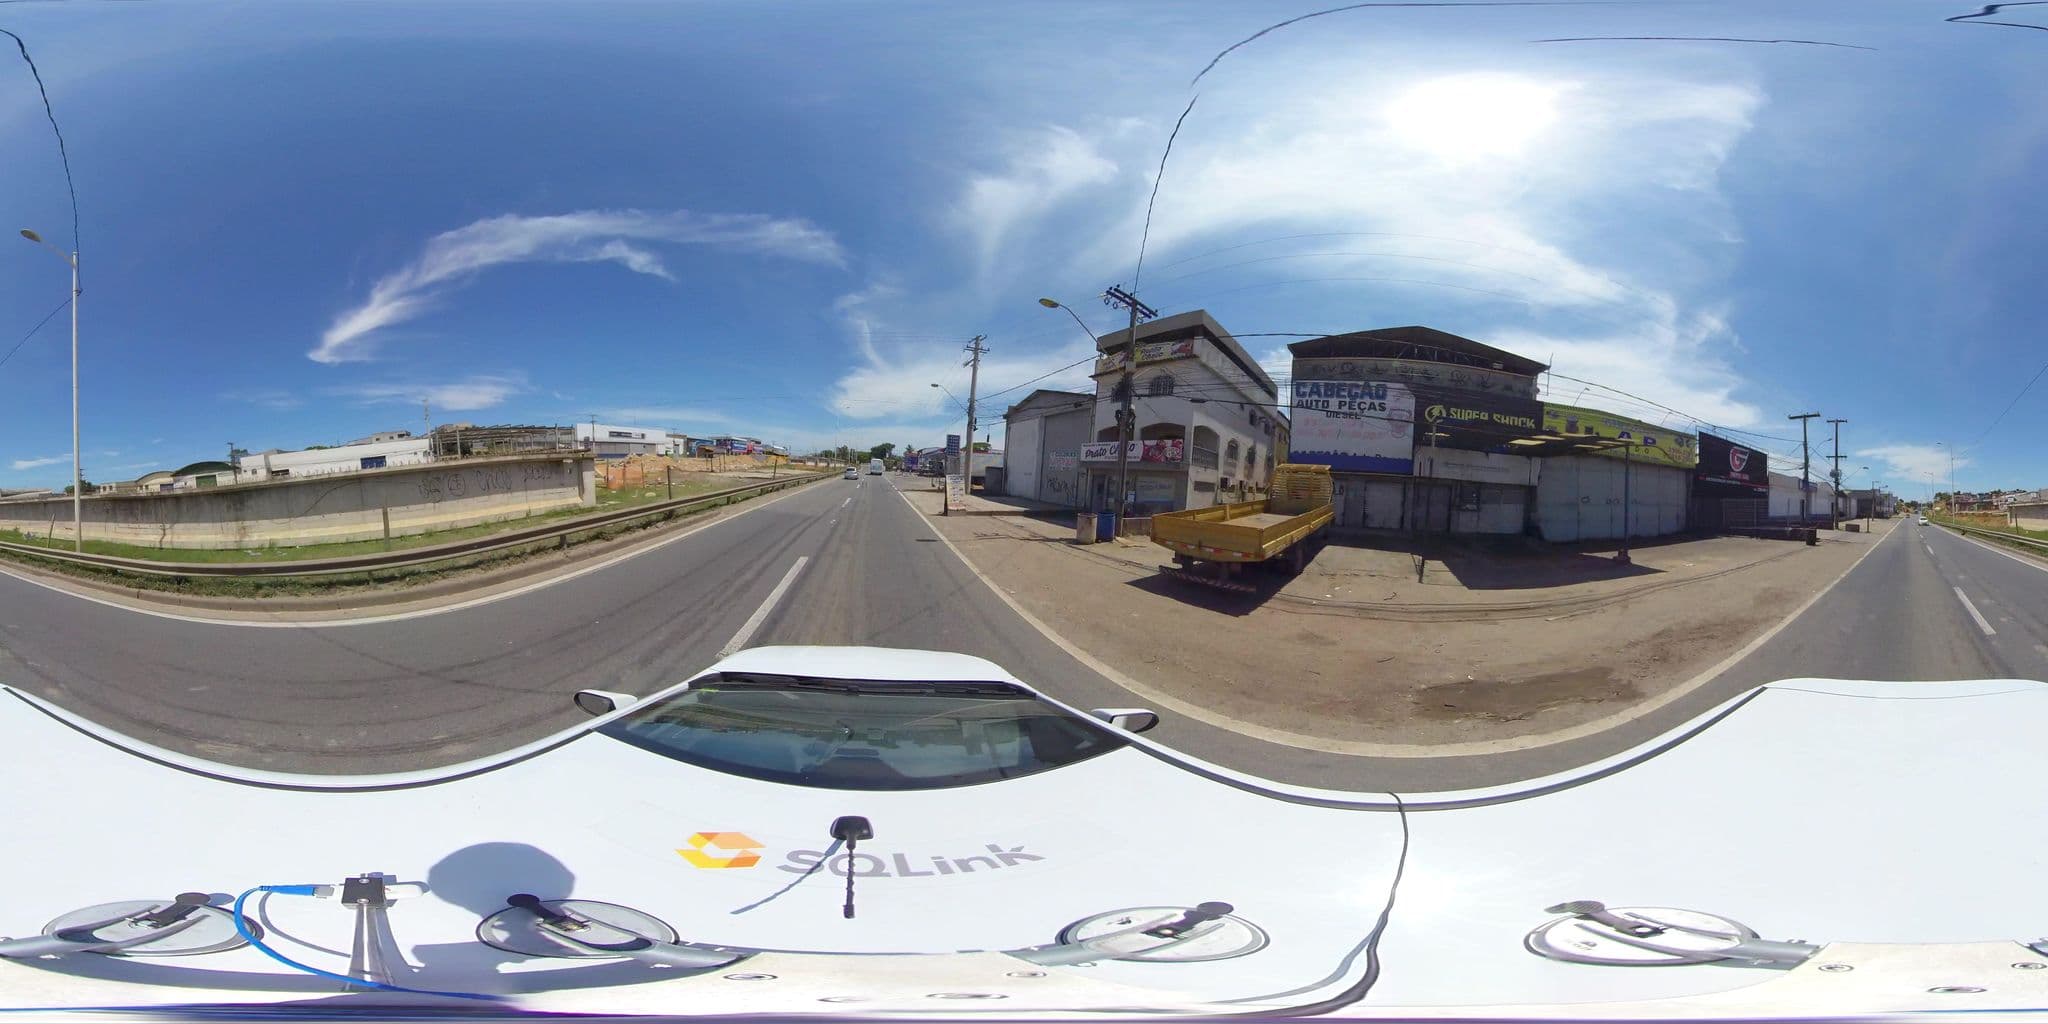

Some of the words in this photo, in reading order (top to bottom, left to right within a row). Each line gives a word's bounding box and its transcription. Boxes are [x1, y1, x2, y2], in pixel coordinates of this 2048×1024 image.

[1296, 381, 1388, 400] CABEÇÃO
[1296, 400, 1329, 409] AUTO
[1338, 400, 1387, 413] PEÇAS
[1326, 411, 1362, 420] DIESEL
[1450, 407, 1489, 421] SUPER
[1493, 413, 1536, 429] SHOCK
[777, 843, 1047, 877] SQLink
